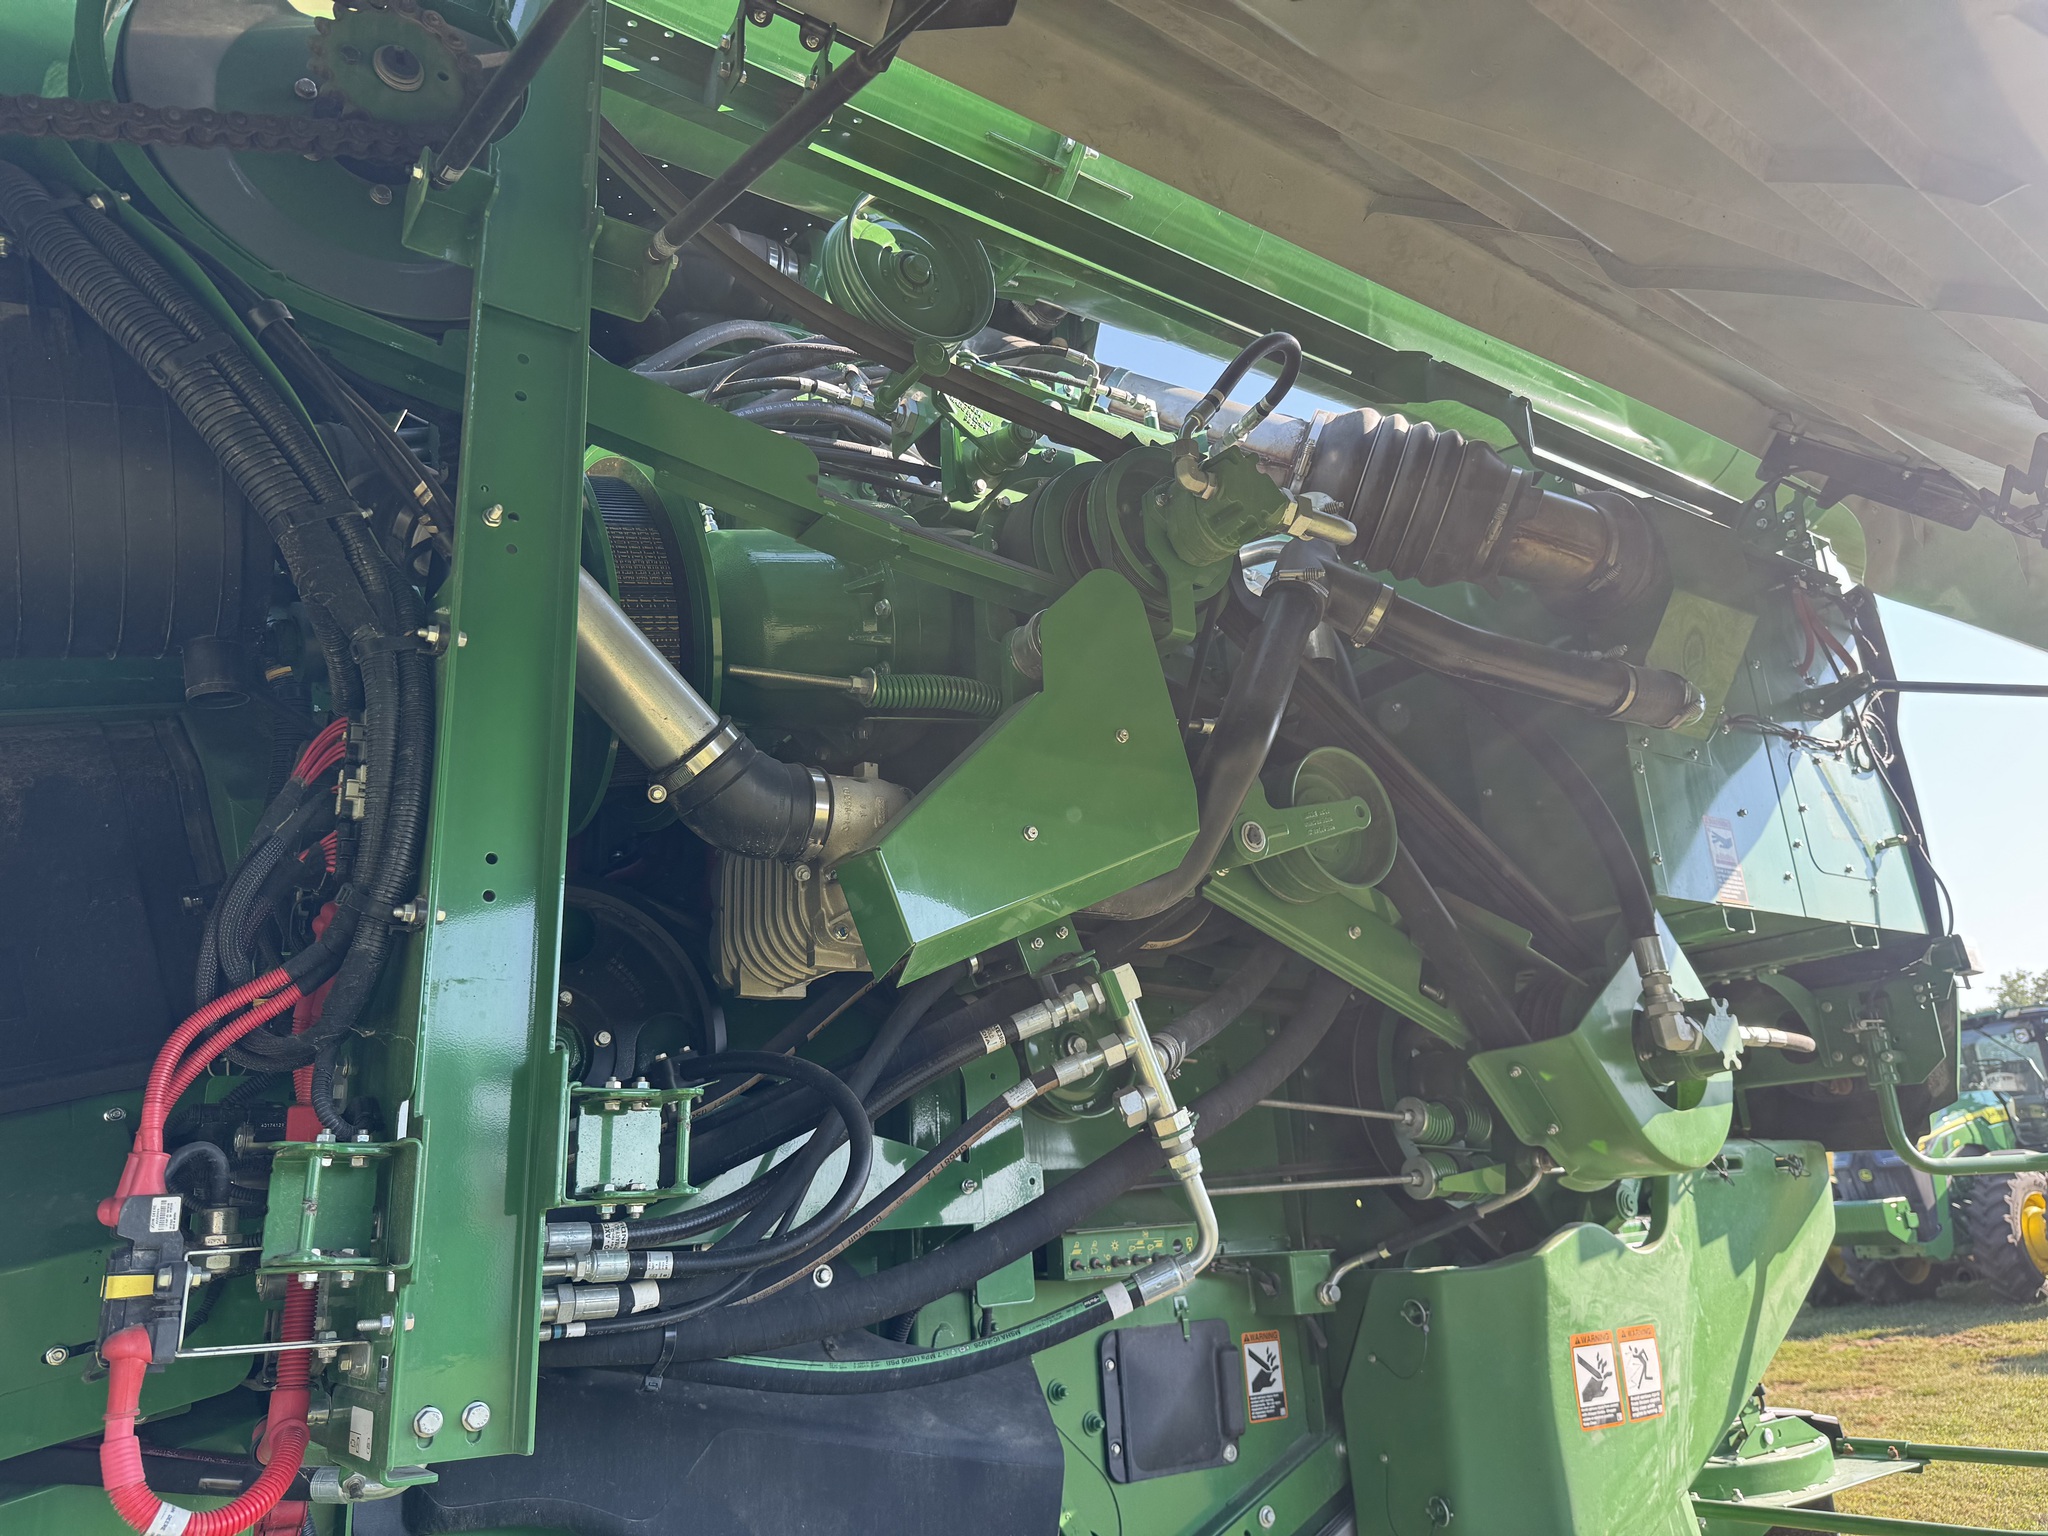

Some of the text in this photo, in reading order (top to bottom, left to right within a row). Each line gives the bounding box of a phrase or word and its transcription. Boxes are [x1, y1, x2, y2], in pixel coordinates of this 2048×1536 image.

[925, 1143, 968, 1181] GH681-12
[847, 1214, 882, 1244] Dura-Tuff
[1000, 1328, 1021, 1340] MSHA
[1249, 1331, 1278, 1341] WARNING
[1581, 1333, 1609, 1344] WARNING
